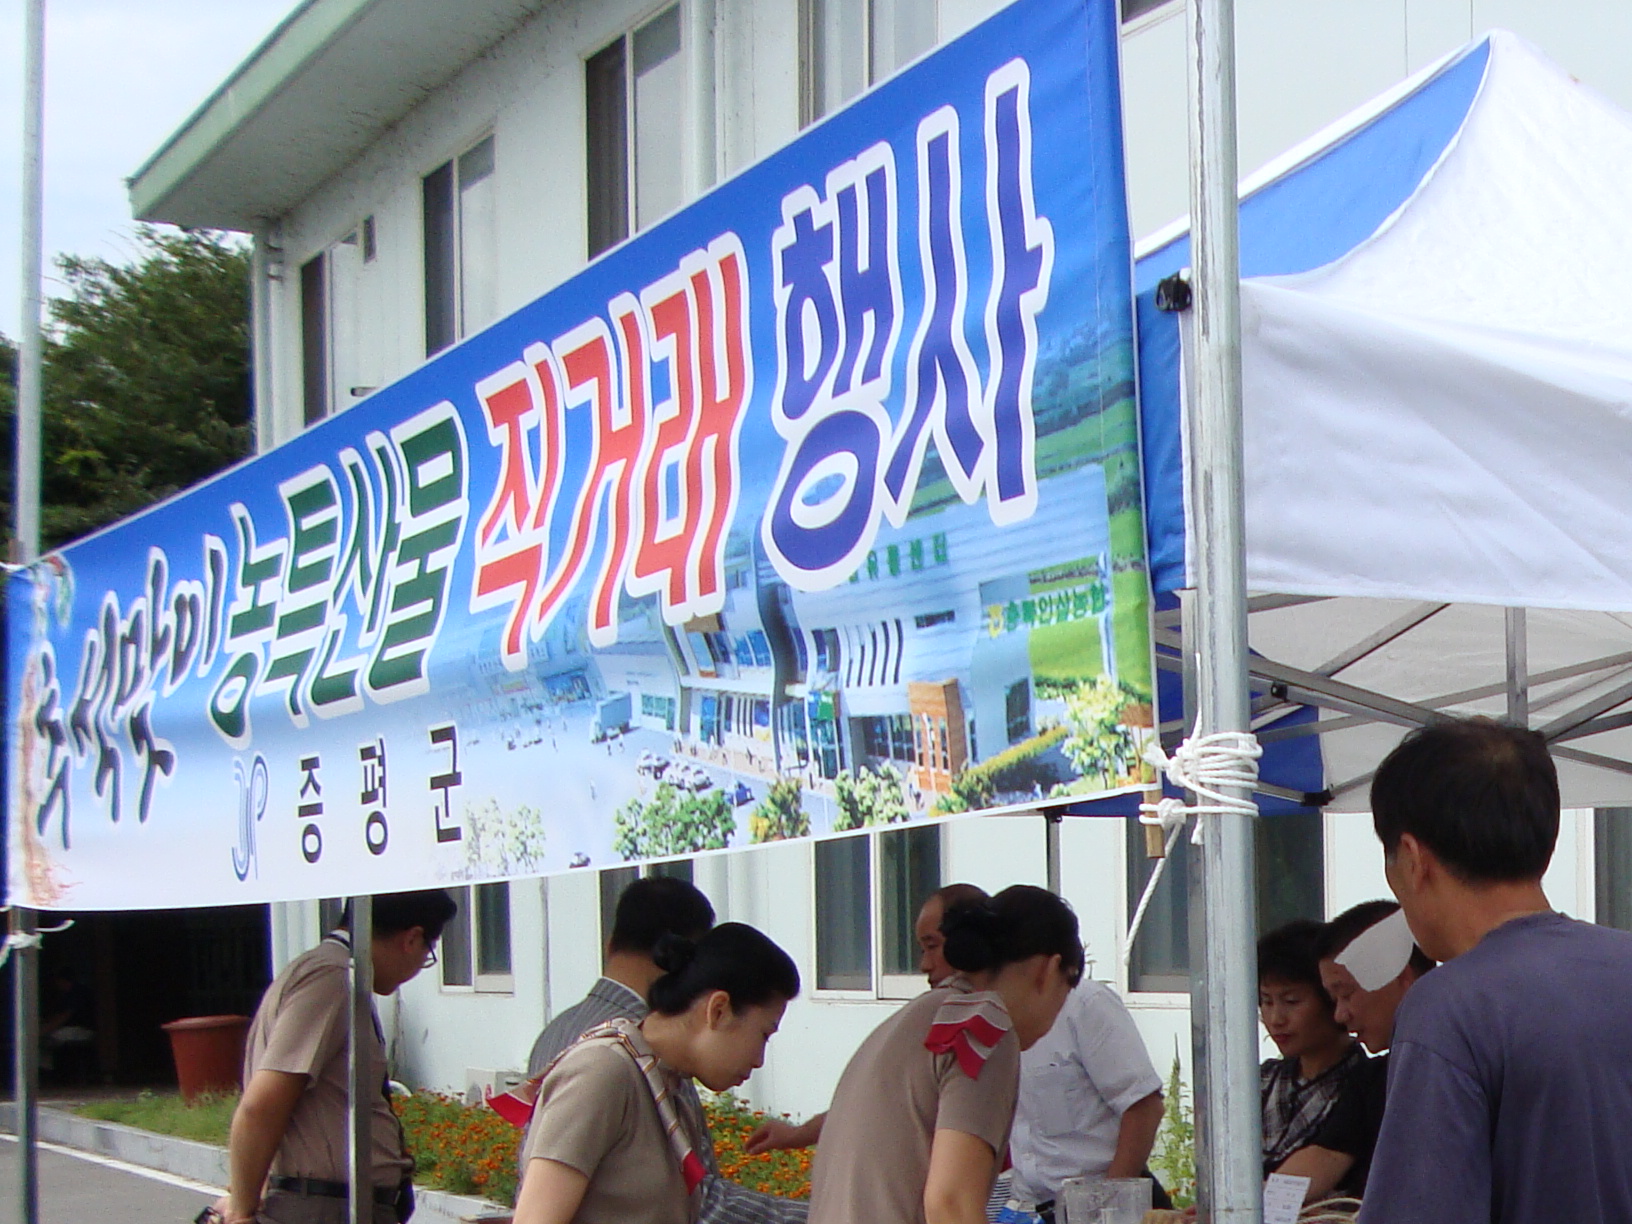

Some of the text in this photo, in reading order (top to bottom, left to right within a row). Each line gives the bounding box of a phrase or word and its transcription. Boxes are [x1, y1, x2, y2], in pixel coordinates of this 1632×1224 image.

[209, 407, 467, 742] 농특산물
[476, 238, 747, 663] 직거래
[766, 66, 1050, 583] 행사
